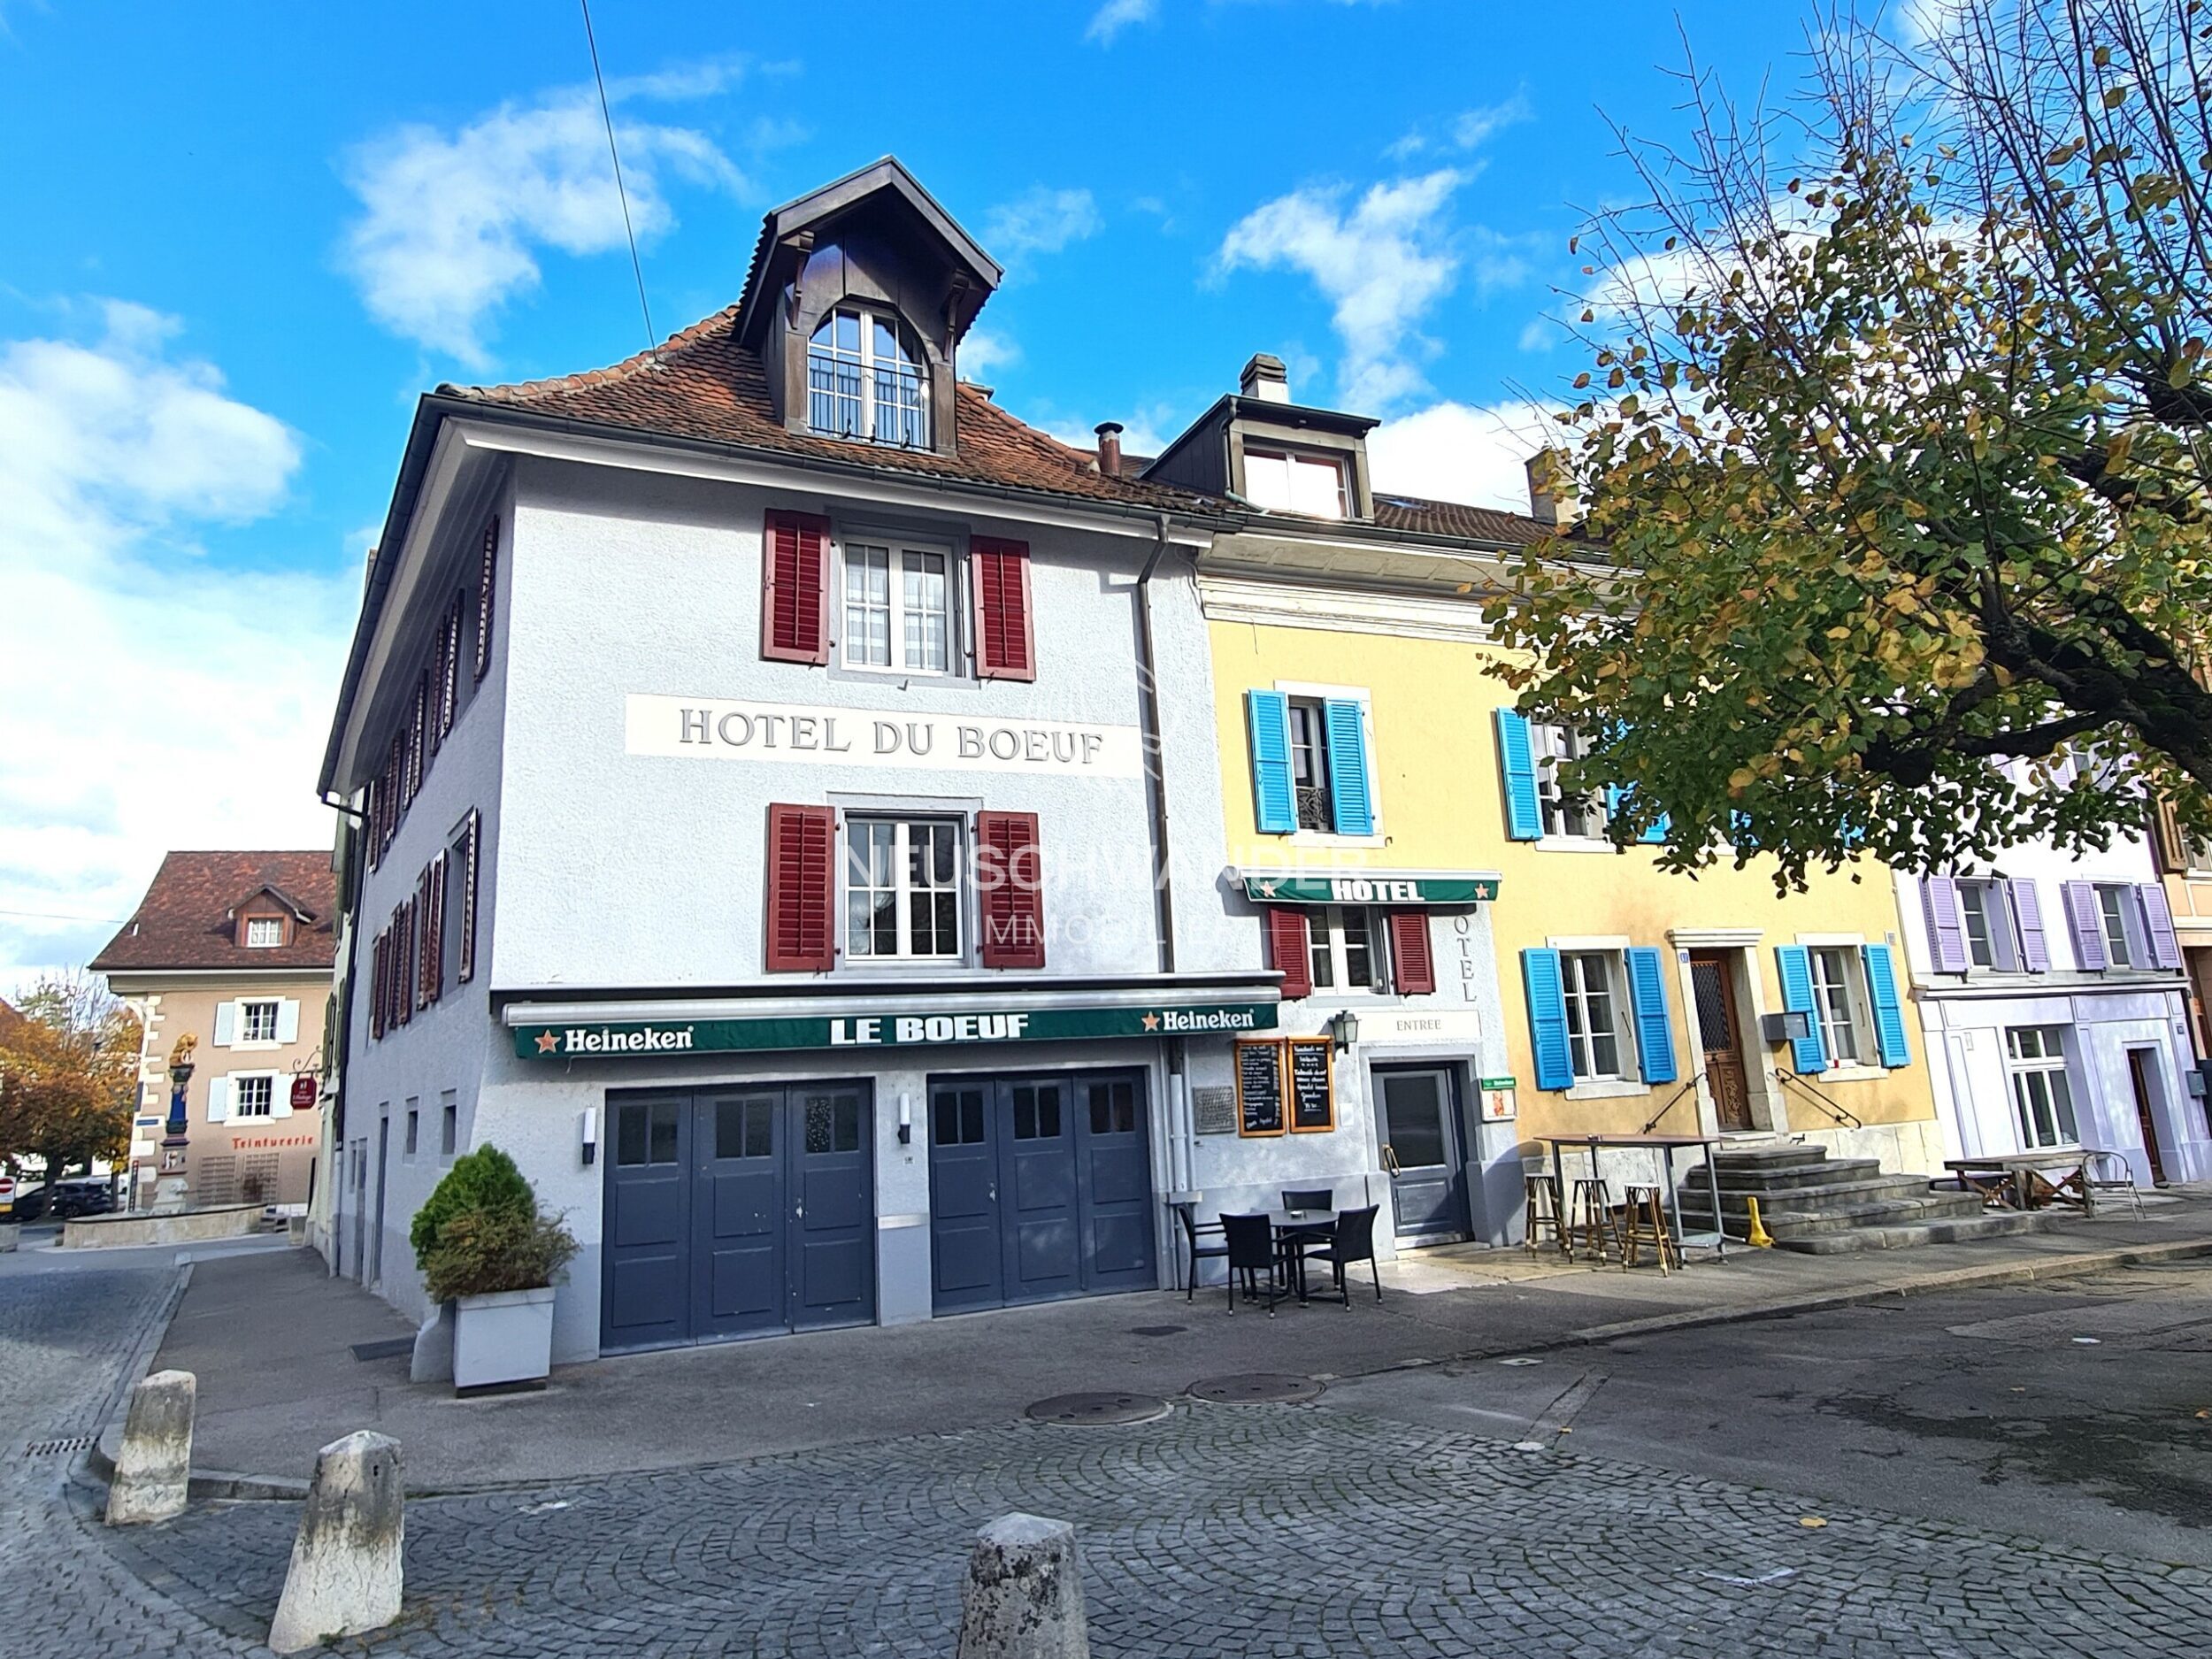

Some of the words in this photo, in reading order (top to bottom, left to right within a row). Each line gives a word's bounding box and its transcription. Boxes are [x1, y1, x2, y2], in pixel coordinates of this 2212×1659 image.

[680, 709, 852, 752] HOTEL
[873, 721, 934, 756] DU
[957, 725, 1103, 764] BOEUF
[1330, 879, 1425, 902] HOTEL
[1454, 915, 1477, 1002] OTEL
[830, 1018, 882, 1046] LE
[895, 1013, 1029, 1043] BOEUF
[1162, 1009, 1255, 1031] Heineken
[1396, 1019, 1441, 1032] ENTREE
[564, 1025, 694, 1052] Heineken
[232, 1135, 313, 1149] Teinturerie
